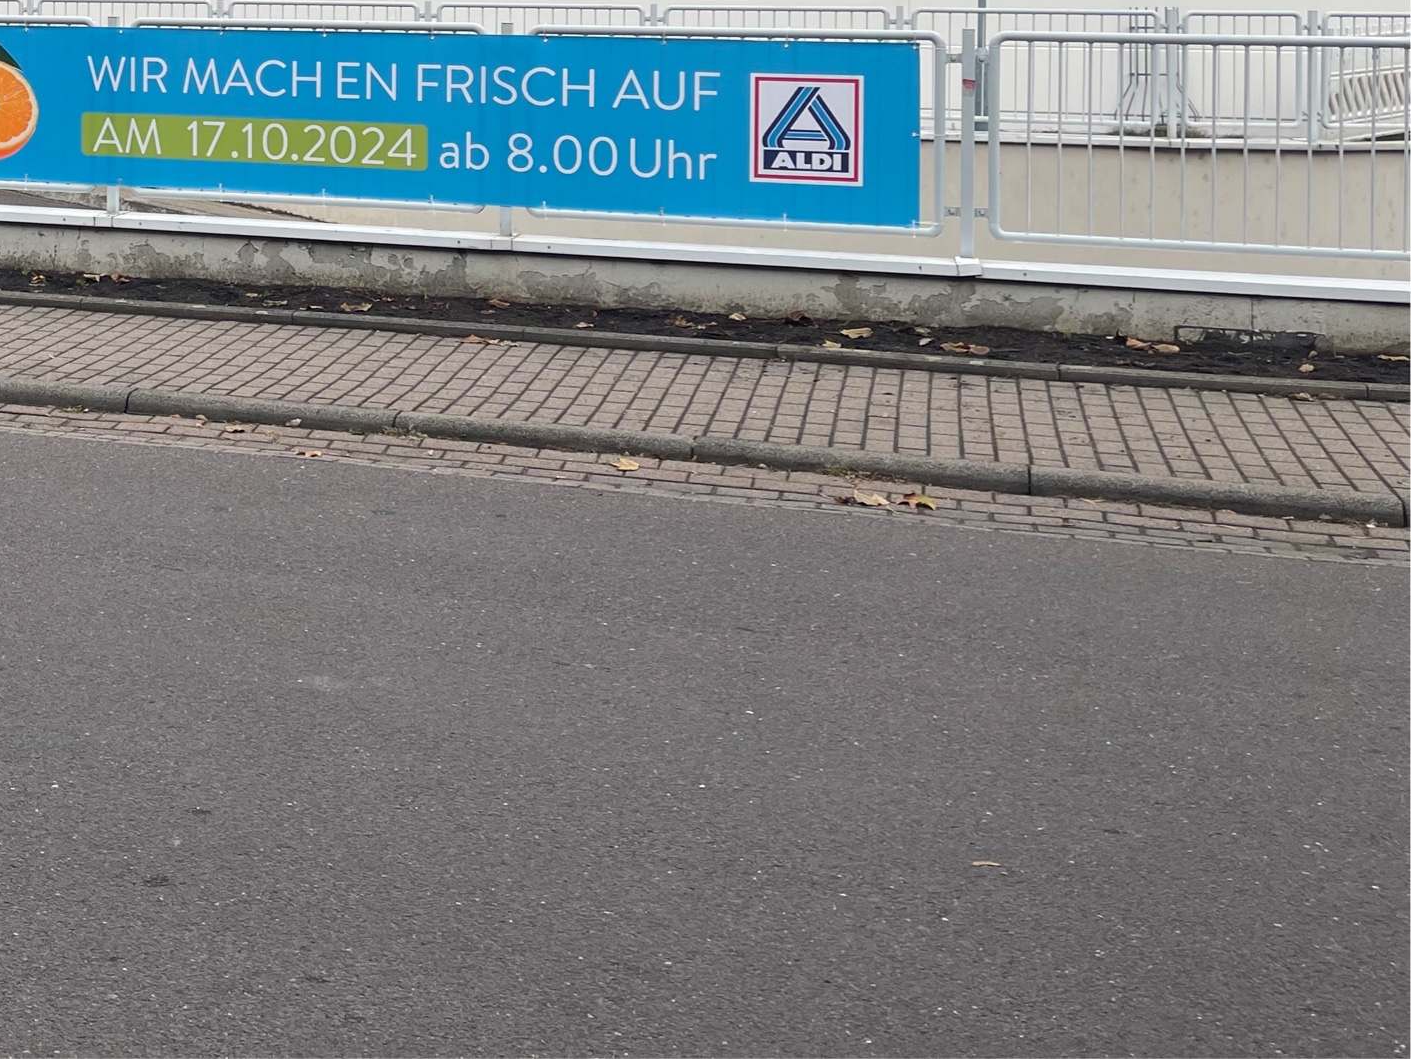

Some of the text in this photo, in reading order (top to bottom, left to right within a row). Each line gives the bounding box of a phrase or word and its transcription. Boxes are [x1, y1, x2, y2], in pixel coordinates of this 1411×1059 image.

[87, 55, 168, 93] WIR
[417, 64, 595, 107] FRISCH
[612, 69, 720, 111] AUF
[92, 116, 162, 155] AM
[186, 120, 418, 167] 17.10.2024
[439, 131, 489, 170] ab
[630, 138, 717, 180] Uhr
[770, 151, 842, 171] ALDI
